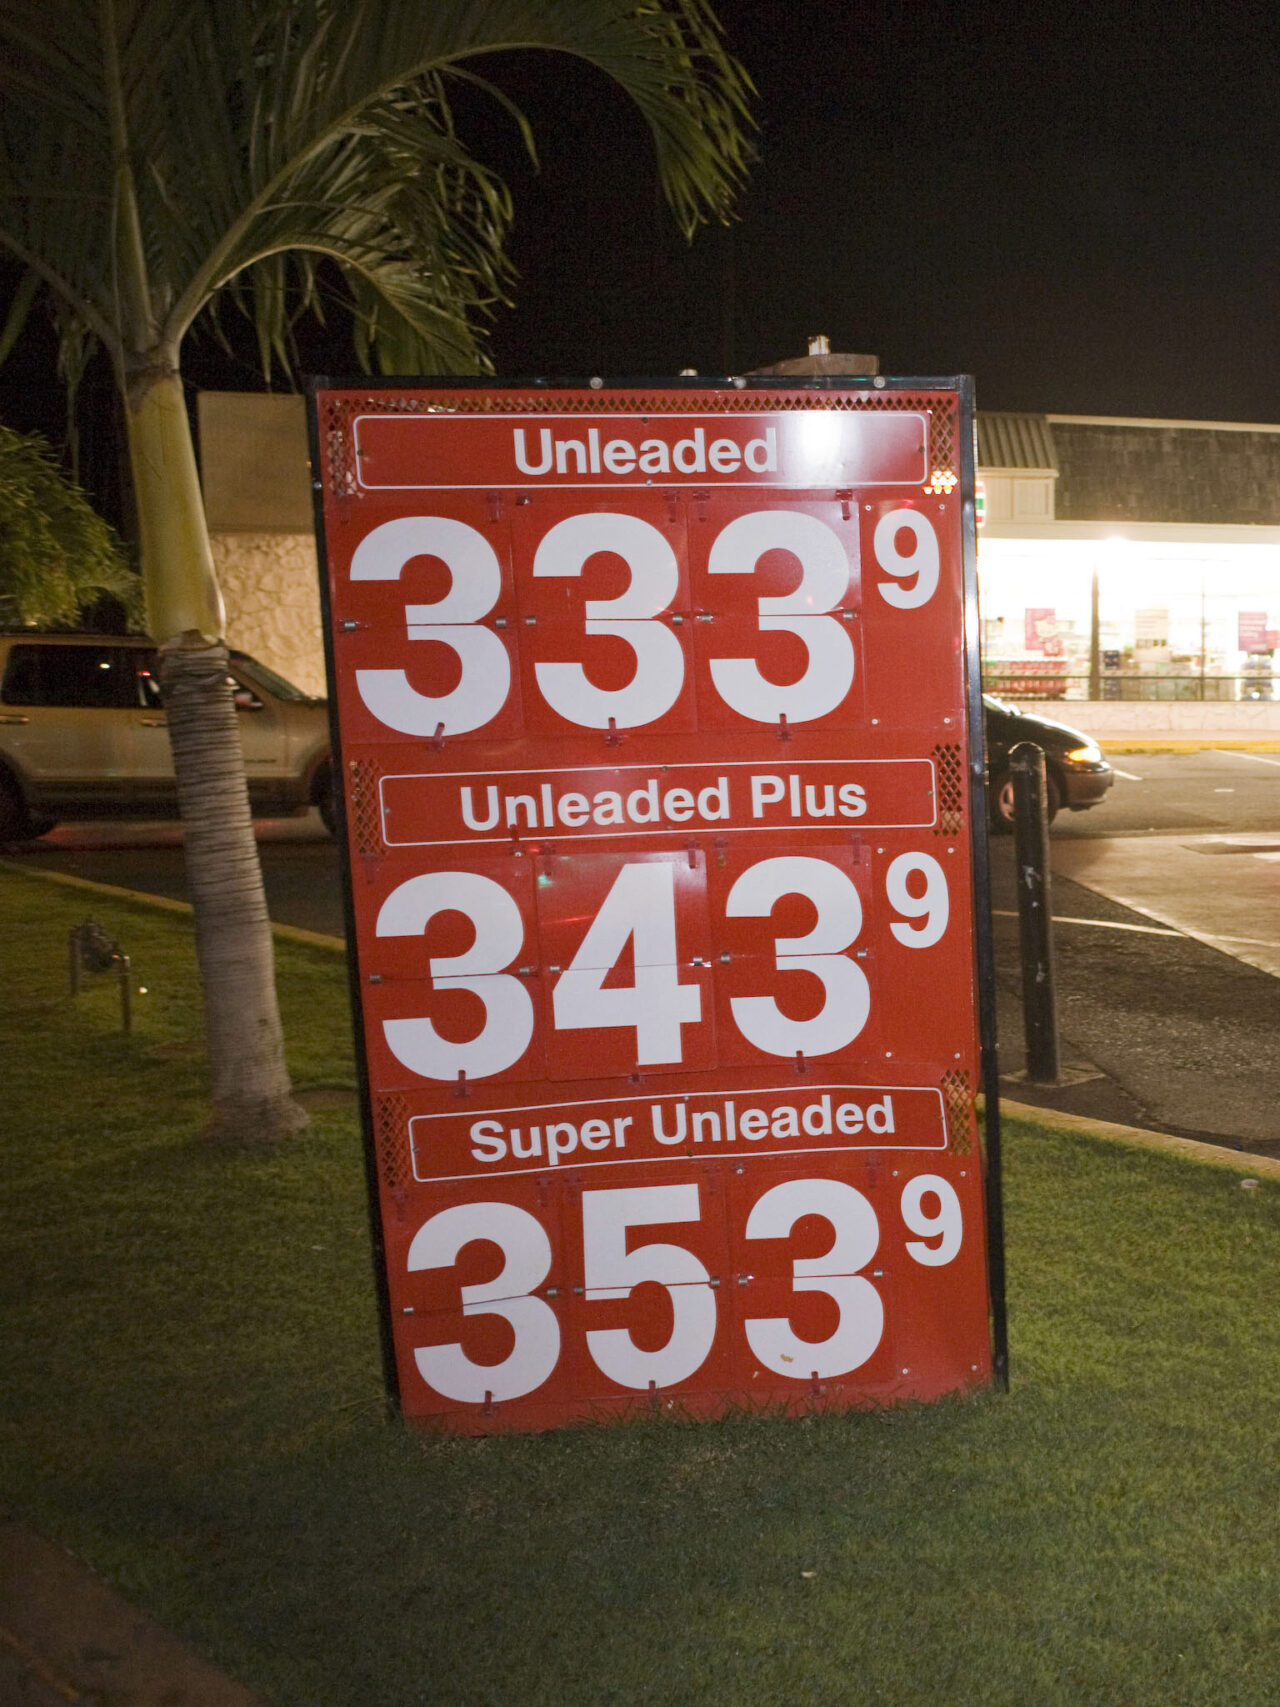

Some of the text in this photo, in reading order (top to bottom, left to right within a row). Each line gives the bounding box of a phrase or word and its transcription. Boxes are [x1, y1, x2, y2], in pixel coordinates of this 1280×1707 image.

[512, 427, 777, 474] Unleaded
[873, 509, 941, 610] 9
[460, 774, 867, 832] Unleaded Plus
[885, 851, 950, 949] 9
[470, 1095, 896, 1166] Super Unleaded
[900, 1174, 963, 1267] 9
